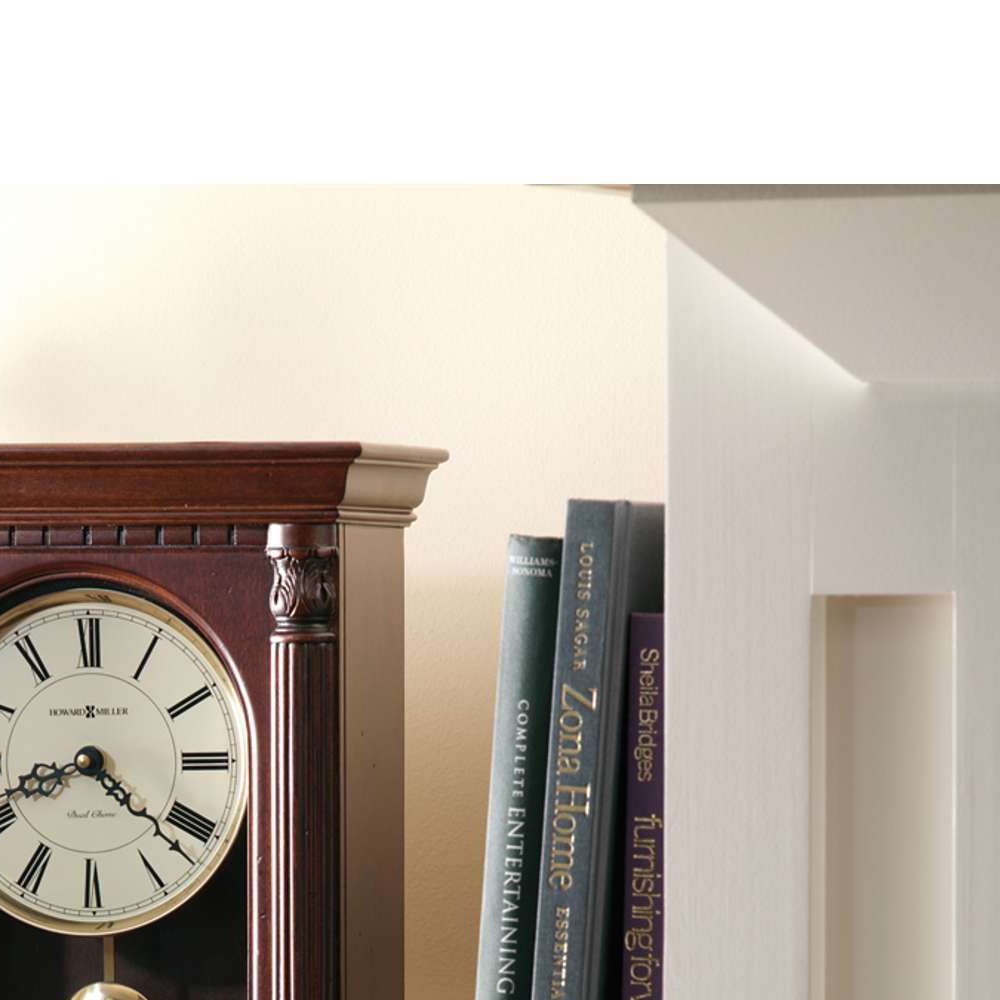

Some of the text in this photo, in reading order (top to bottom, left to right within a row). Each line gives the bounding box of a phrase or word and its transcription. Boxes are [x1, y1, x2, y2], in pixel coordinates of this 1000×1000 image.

[577, 542, 594, 600] LOUIS
[76, 618, 104, 669] XII
[572, 607, 590, 672] SAGAR
[49, 706, 129, 717] HOWARD MILLER
[639, 648, 660, 707] Sheila
[511, 699, 530, 798] COMPLETE
[556, 683, 598, 776] Zona
[633, 708, 659, 782] Bridges
[548, 780, 592, 892] Home
[496, 806, 526, 995] ENTERTAINING
[624, 814, 663, 953] furnishing
